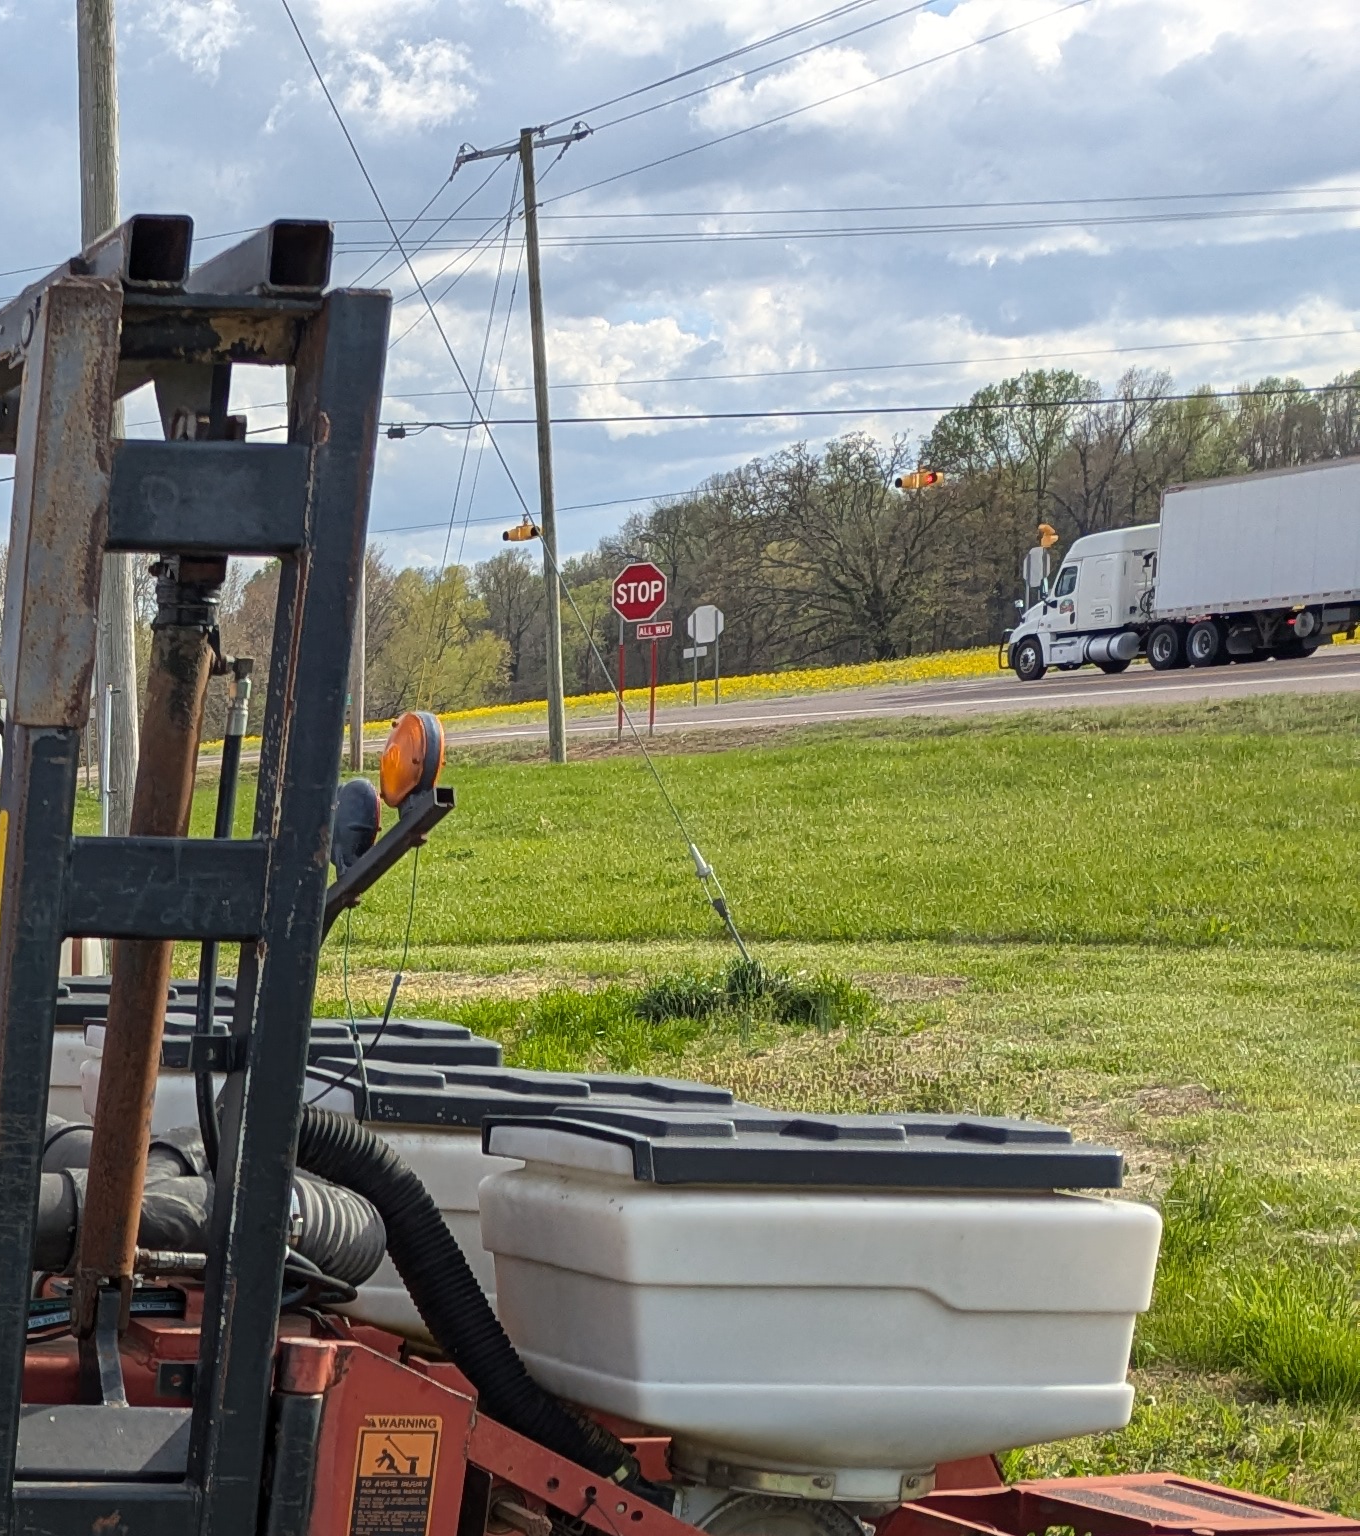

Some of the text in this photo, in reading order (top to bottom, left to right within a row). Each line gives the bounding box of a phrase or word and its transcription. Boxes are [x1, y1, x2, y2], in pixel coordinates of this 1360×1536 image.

[616, 580, 662, 605] STOP
[639, 624, 671, 636] ALL WAY
[378, 1418, 437, 1429] WARNING
